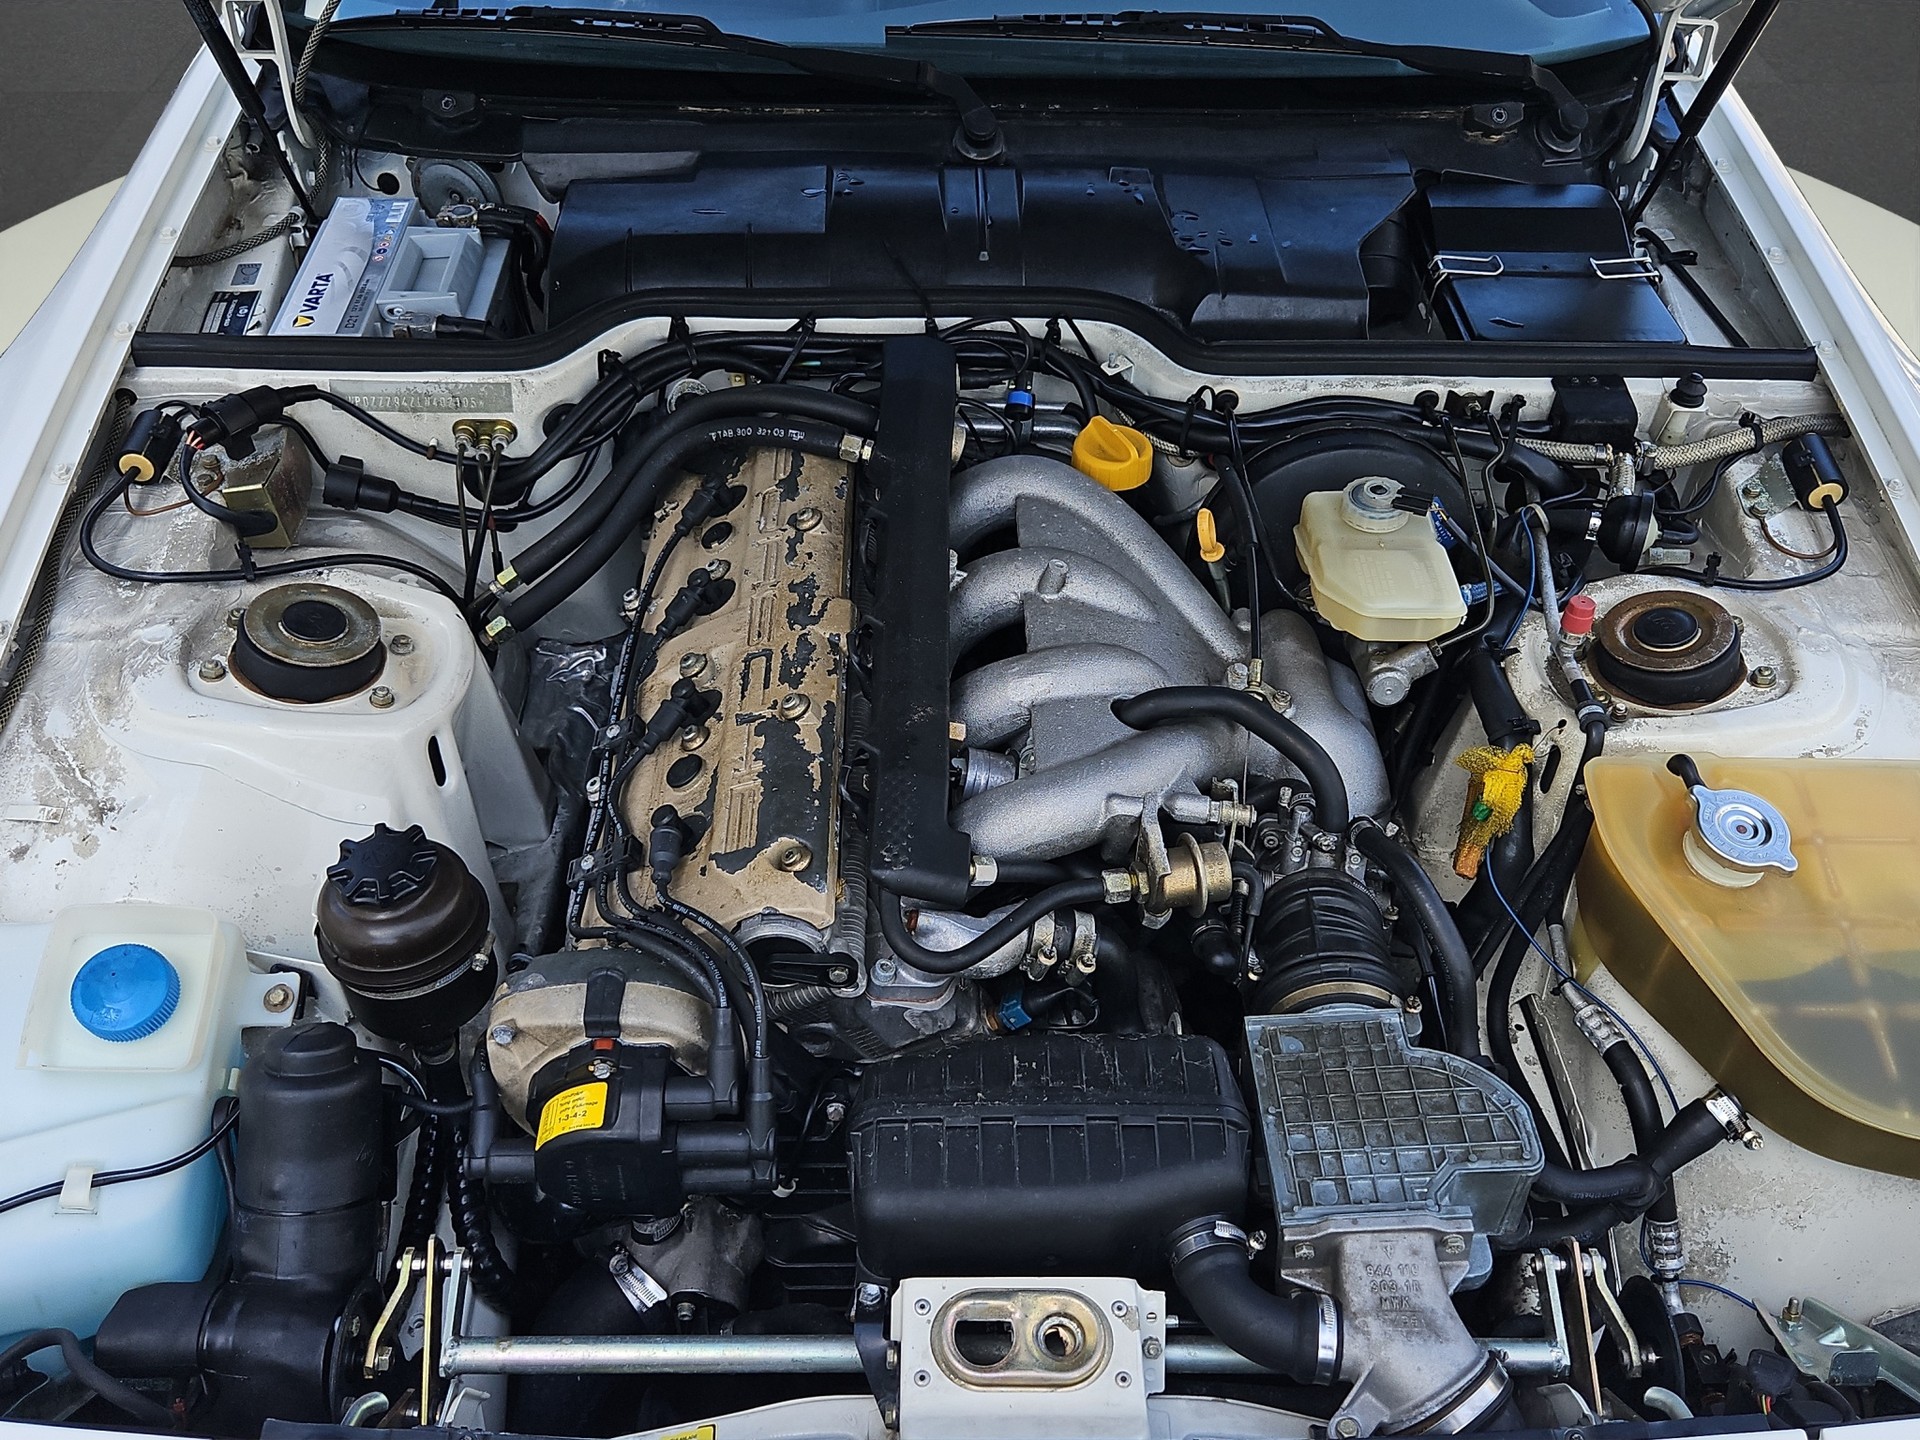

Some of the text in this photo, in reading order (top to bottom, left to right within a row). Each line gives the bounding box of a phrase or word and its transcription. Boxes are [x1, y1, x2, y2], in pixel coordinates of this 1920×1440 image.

[299, 273, 334, 313] VARTA
[344, 315, 359, 329] D21
[672, 903, 688, 915] BERU
[697, 916, 714, 930] BERU
[722, 934, 739, 952] BERU
[558, 1110, 588, 1124] 1-3-4-2
[1365, 1263, 1393, 1278] 944
